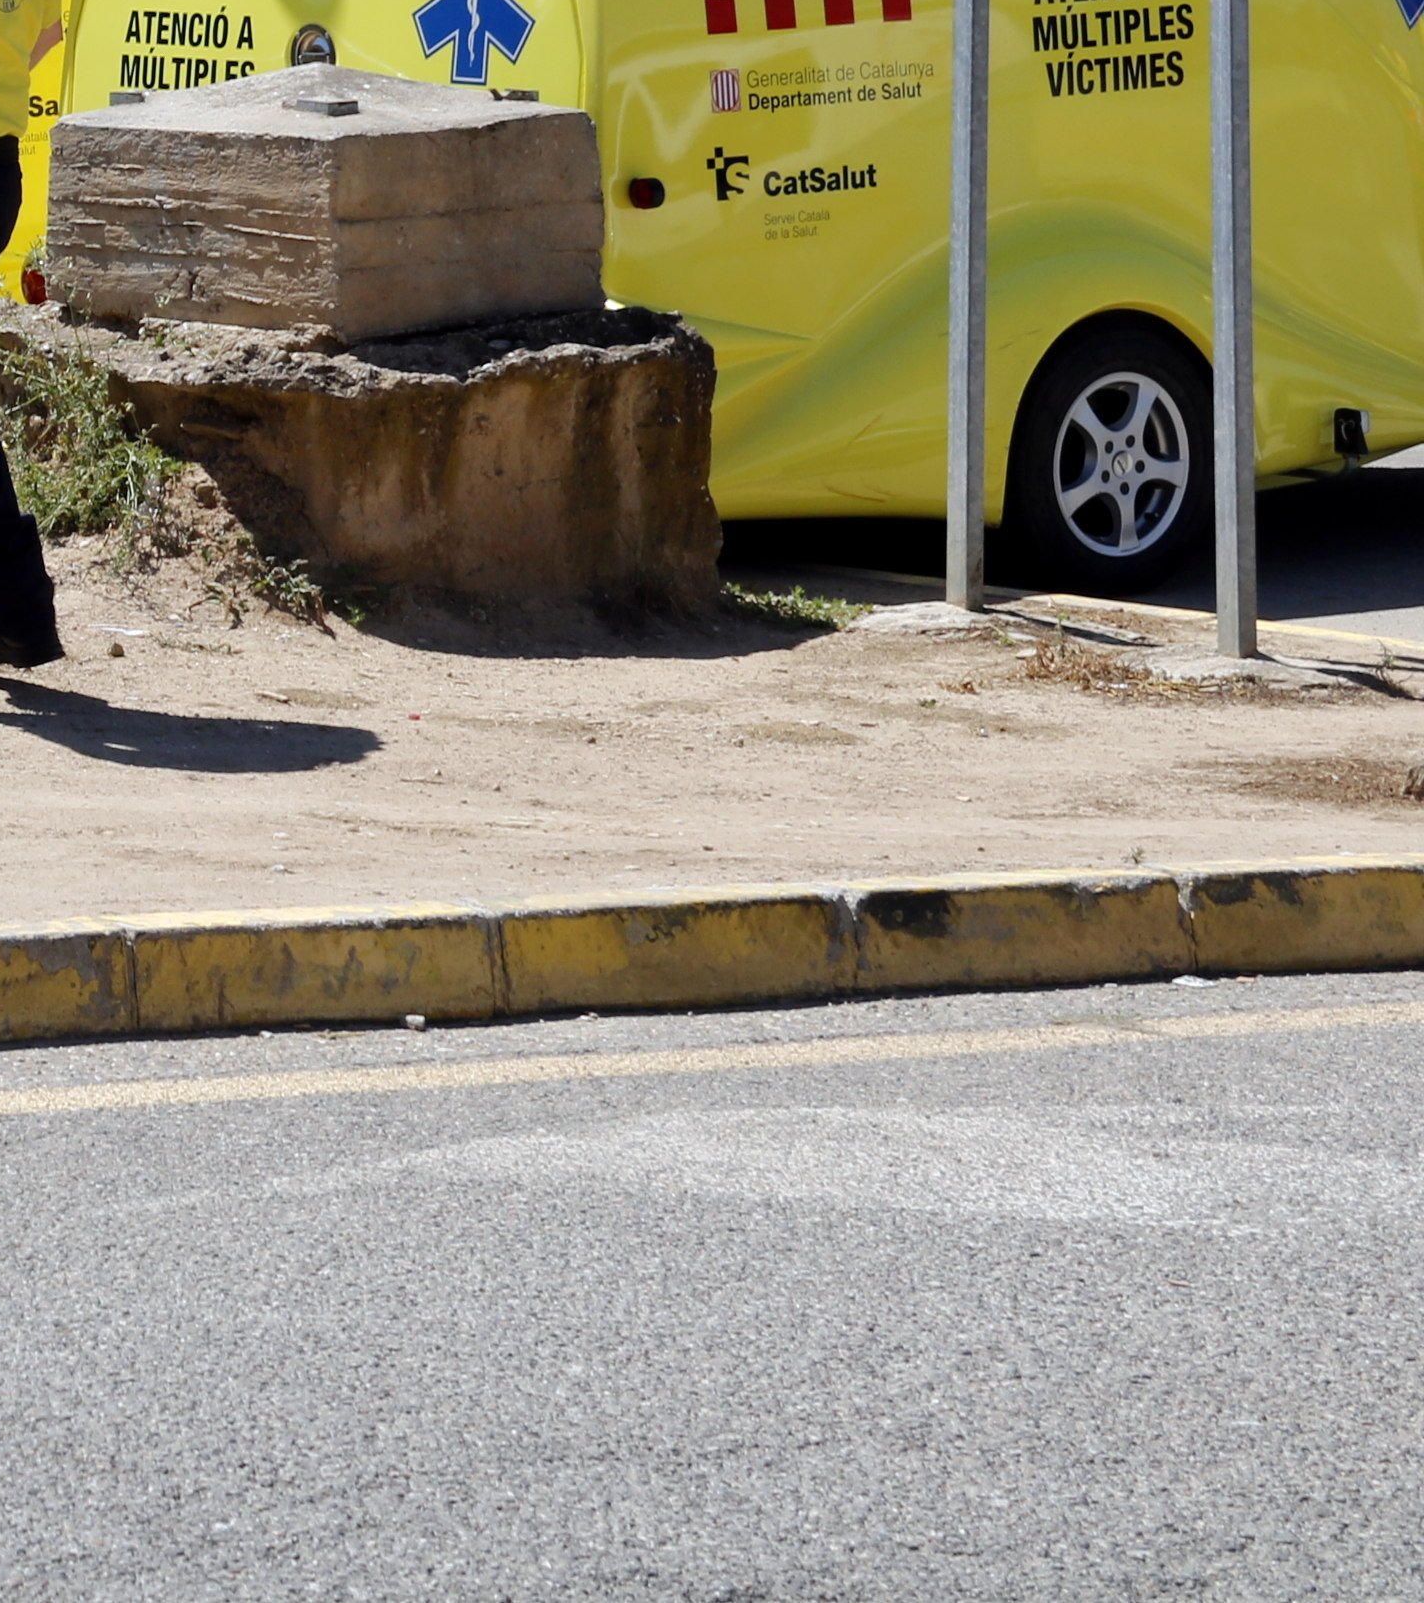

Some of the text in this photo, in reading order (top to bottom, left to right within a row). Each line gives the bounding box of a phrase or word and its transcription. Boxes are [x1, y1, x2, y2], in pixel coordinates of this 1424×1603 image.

[125, 5, 254, 50] ATENCIÓ A
[1032, 3, 1194, 52] MÚLTIPLES
[746, 60, 935, 89] Generalitat de Catalunya
[1045, 50, 1185, 98] VÍCTIMES
[748, 81, 922, 113] Departament de Salut
[18, 146, 36, 156] alut
[19, 130, 49, 143] atalà
[763, 163, 877, 197] CatSalut
[763, 209, 831, 226] Servei Català
[764, 224, 817, 241] de la Salut
